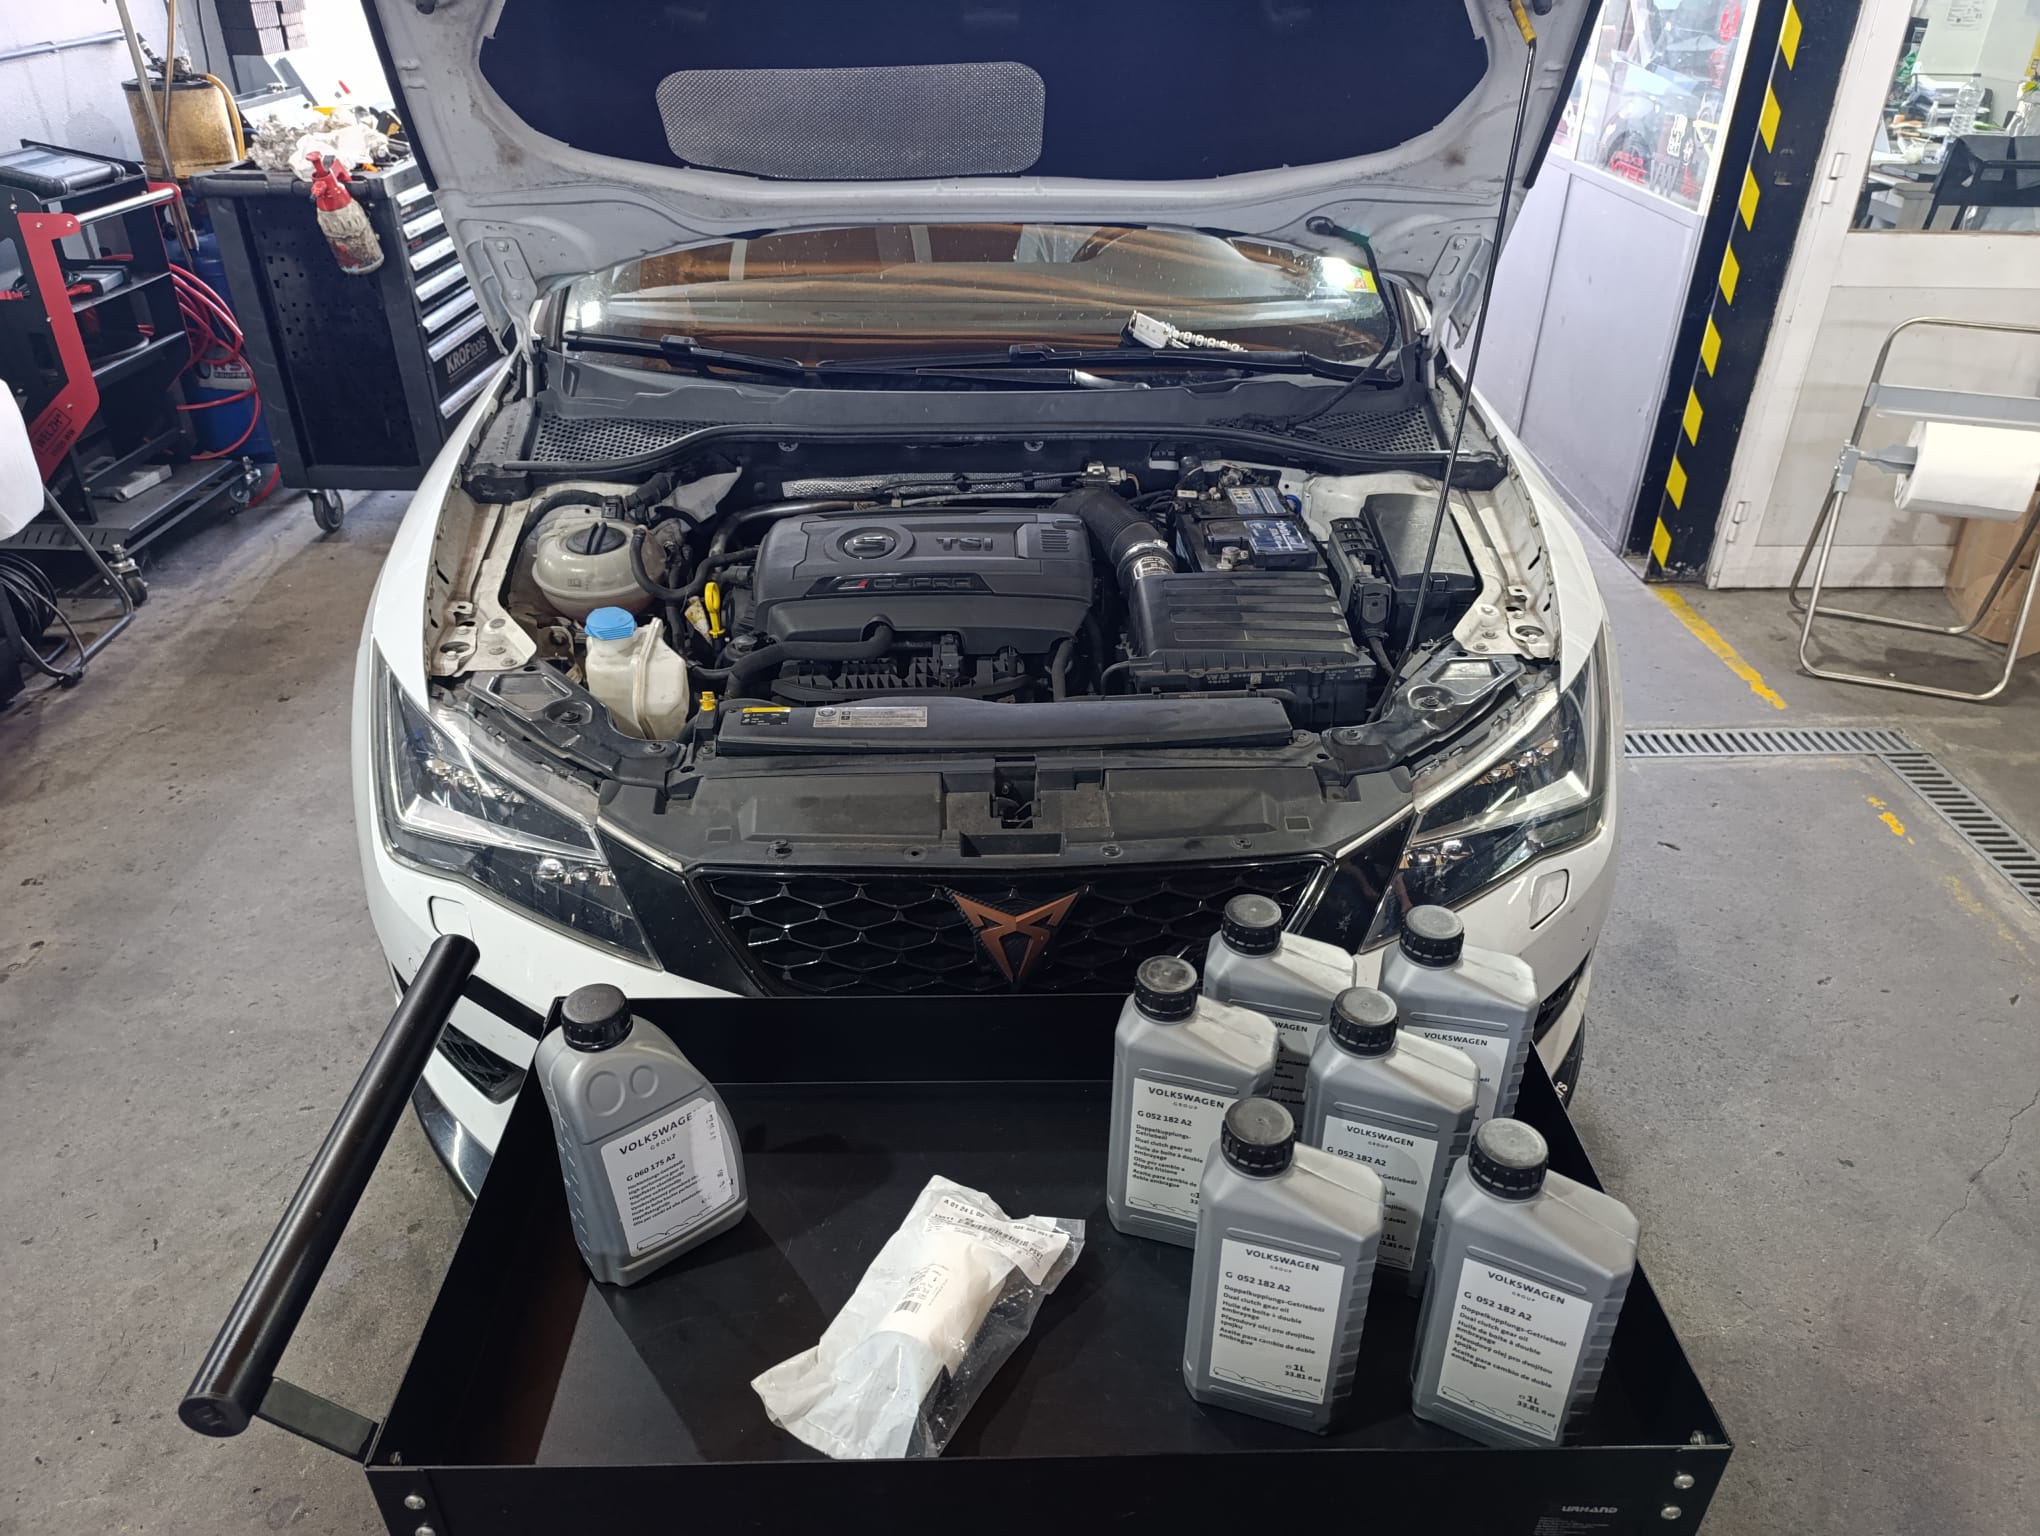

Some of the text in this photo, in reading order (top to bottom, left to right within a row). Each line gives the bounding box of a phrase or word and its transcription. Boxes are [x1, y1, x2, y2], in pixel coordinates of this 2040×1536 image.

[936, 537, 993, 551] TSI
[873, 577, 972, 588] CUPRA
[1424, 1032, 1488, 1046] VOLKSWAGEN
[1148, 1086, 1224, 1108] VOLKSWAGEN
[1172, 1101, 1197, 1109] GROUP
[1145, 1112, 1161, 1120] 052
[1163, 1115, 1178, 1123] 182
[619, 1112, 694, 1155] VOLKSWAGE
[1346, 1125, 1414, 1147] VOLKSWAGEN
[1134, 1143, 1150, 1151] Huile
[1182, 1154, 1203, 1163] double
[1337, 1148, 1354, 1158] 052
[1355, 1153, 1372, 1163] 182
[1374, 1158, 1386, 1166] A2
[634, 1167, 649, 1178] 060
[650, 1159, 664, 1170] 175
[666, 1153, 675, 1162] A2
[1245, 1248, 1319, 1271] VOLKSWAGEN
[1236, 1274, 1255, 1283] 052
[1257, 1278, 1275, 1288] 182
[1276, 1284, 1290, 1292] A2
[1488, 1271, 1564, 1304] VOLKSWAGEN
[1223, 1292, 1239, 1300] Dual
[1240, 1297, 1261, 1306] clutch
[1511, 1291, 1535, 1301] GROUP
[1221, 1306, 1259, 1320] embrayage
[1222, 1300, 1240, 1309] Huile
[1277, 1314, 1302, 1324] double
[1476, 1295, 1494, 1307] 052
[1497, 1303, 1515, 1315] 182
[1517, 1311, 1532, 1321] A2
[1220, 1320, 1243, 1329] spojku
[1459, 1312, 1476, 1322] Dual
[1477, 1320, 1499, 1331] clutch
[1500, 1329, 1517, 1337] gear
[1218, 1333, 1253, 1345] embrague
[1219, 1327, 1240, 1336] Aceite
[1258, 1338, 1284, 1348] cambio
[1285, 1330, 1314, 1340] dvojitou
[1456, 1326, 1496, 1344] embrayage
[1458, 1320, 1476, 1331] Huile
[1514, 1342, 1540, 1355] double
[1454, 1339, 1477, 1352] spojku
[1293, 1364, 1304, 1372] 1L
[1450, 1352, 1486, 1370] embrague
[1452, 1346, 1474, 1358] Aceite
[1475, 1356, 1491, 1366] para
[1492, 1363, 1519, 1376] cambio
[1530, 1378, 1552, 1388] doble
[1492, 1349, 1507, 1358] olej
[1521, 1360, 1552, 1374] dvojitou
[1284, 1370, 1305, 1379] 33.81
[1517, 1400, 1539, 1413] 33.81
[1526, 1395, 1539, 1405] 1L
